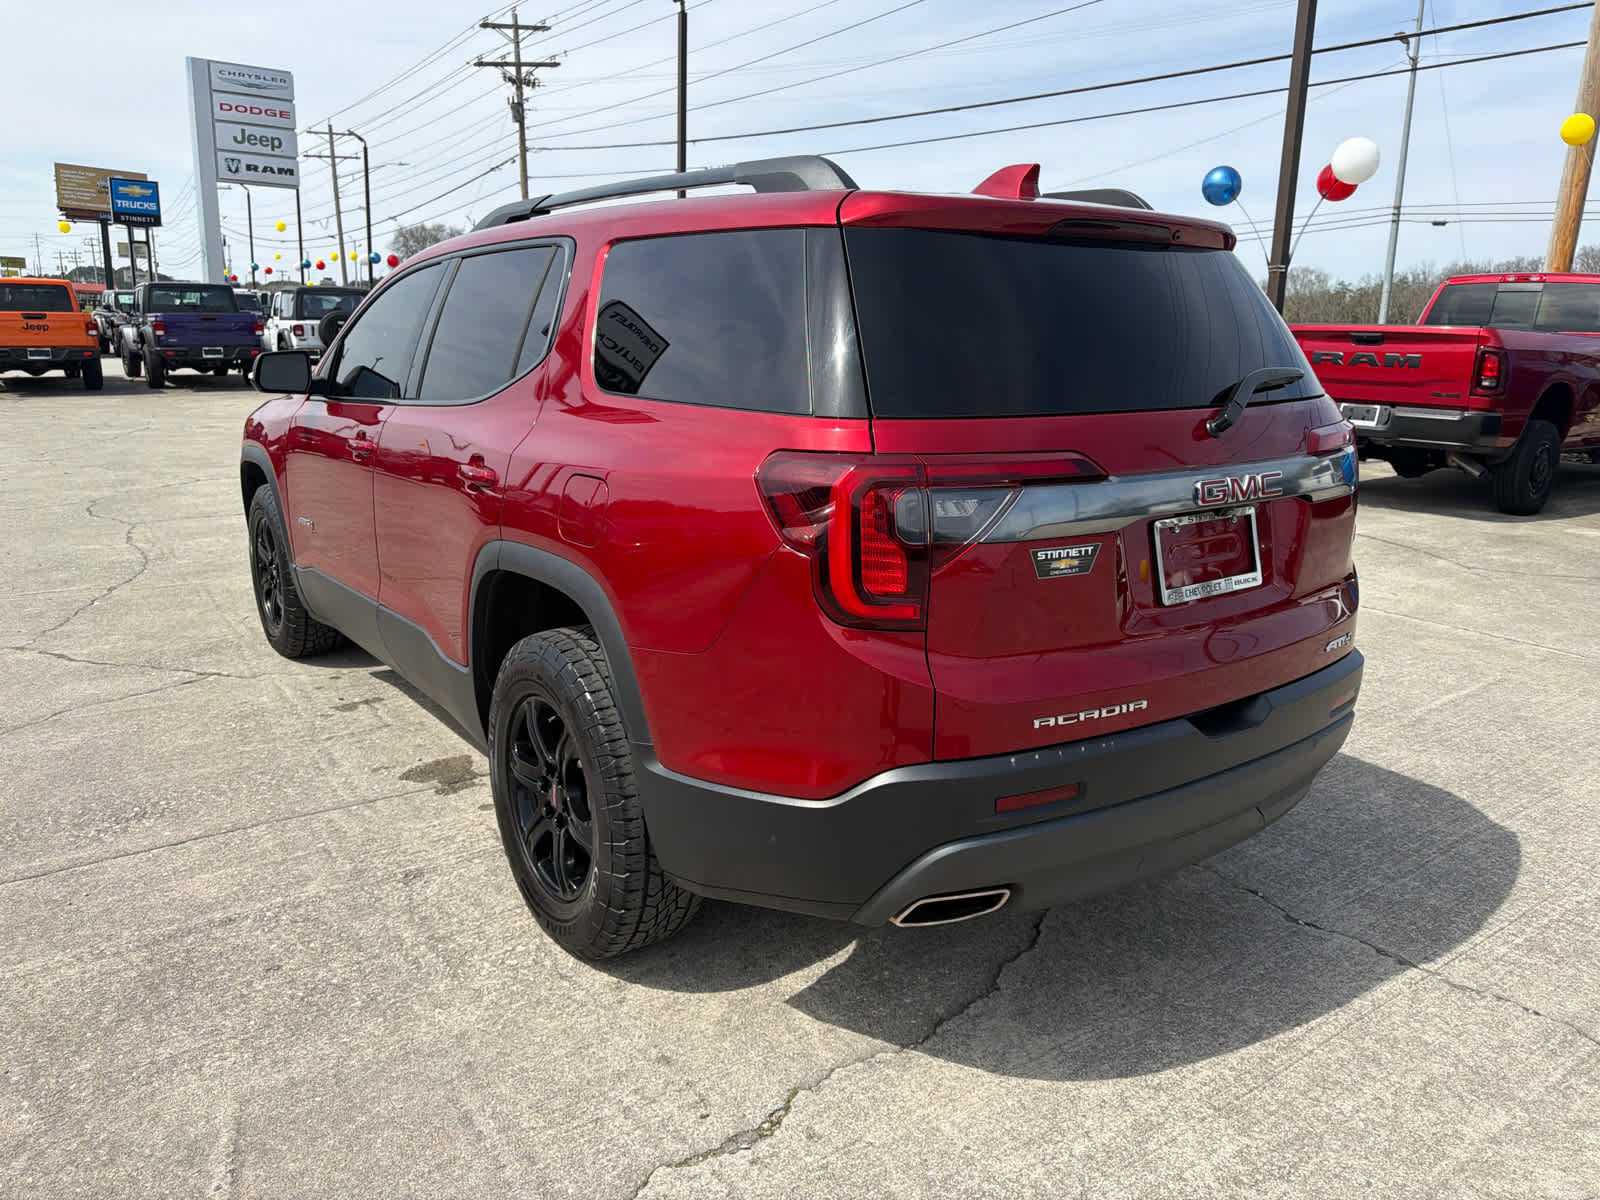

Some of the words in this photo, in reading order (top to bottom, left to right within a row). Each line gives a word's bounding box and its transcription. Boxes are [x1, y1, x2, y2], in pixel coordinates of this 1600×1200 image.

[219, 70, 287, 84] CHRYSLER
[219, 103, 291, 120] DODGE
[232, 128, 283, 151] Jeep
[245, 164, 295, 176] RAM
[115, 200, 157, 210] TRUCKS
[21, 322, 50, 332] Jeep
[1312, 351, 1422, 369] RAM
[1196, 471, 1283, 505] GMC
[1037, 546, 1094, 560] STINNETT
[1184, 582, 1222, 598] CHEVROLET
[1234, 576, 1258, 586] BUICK
[1033, 699, 1148, 729] ACADIA
